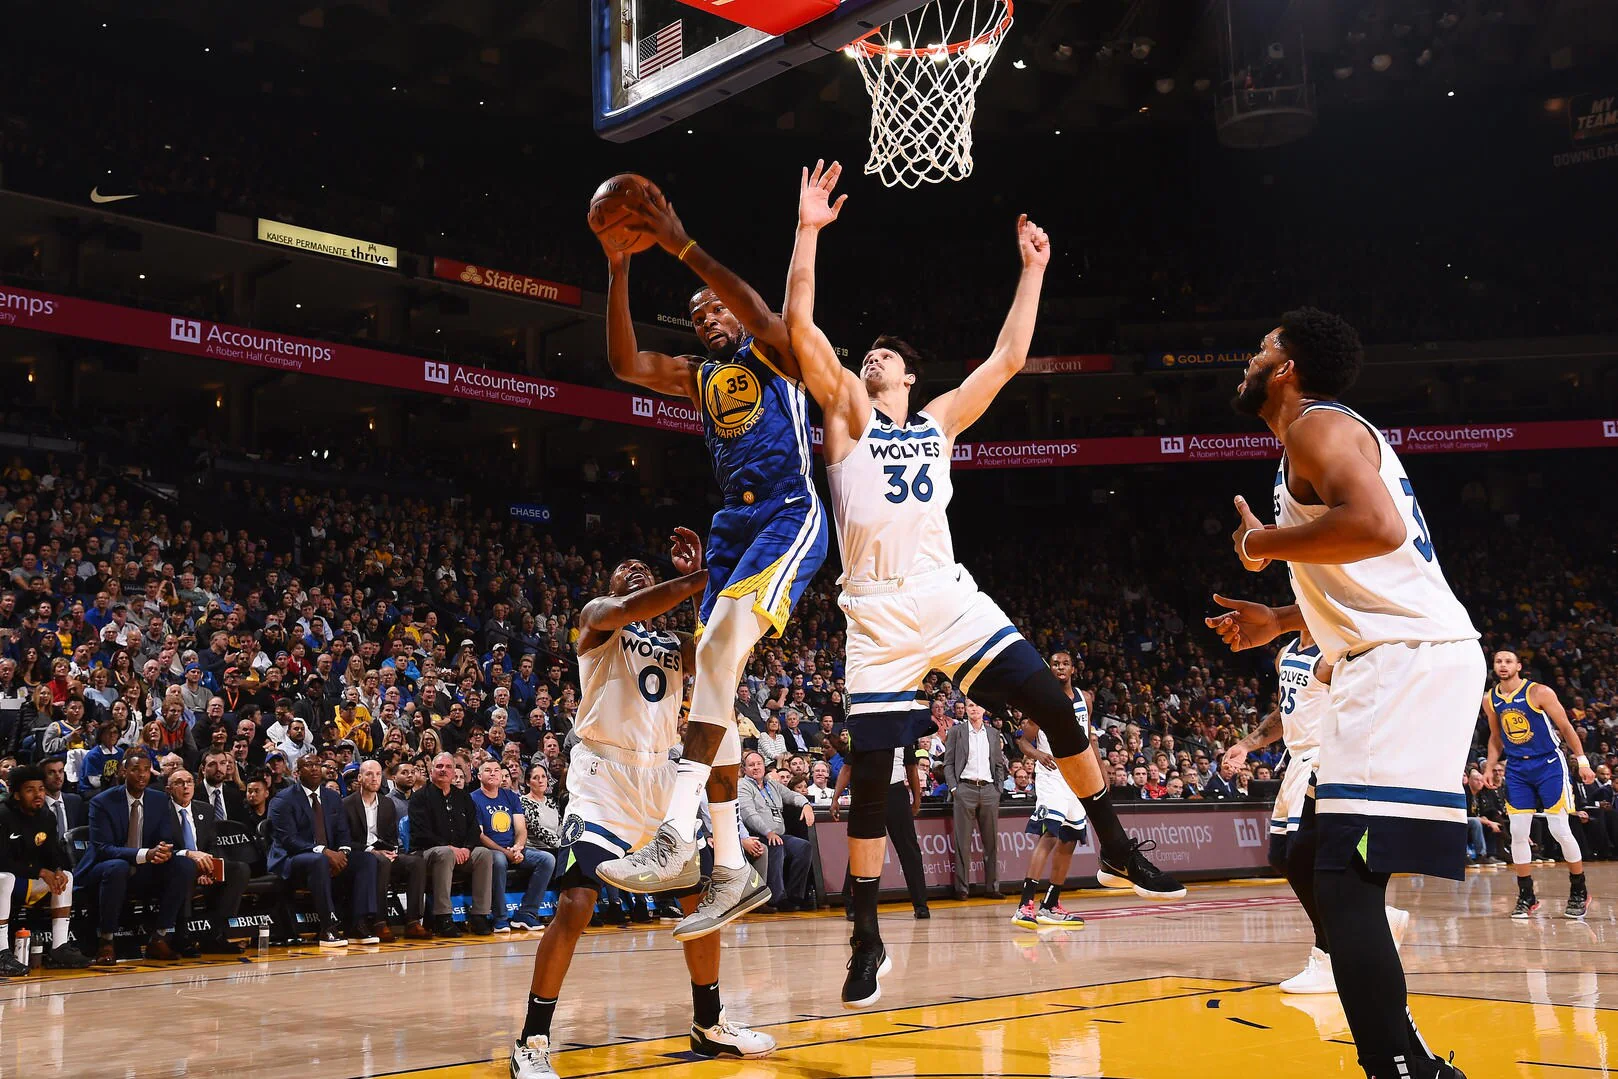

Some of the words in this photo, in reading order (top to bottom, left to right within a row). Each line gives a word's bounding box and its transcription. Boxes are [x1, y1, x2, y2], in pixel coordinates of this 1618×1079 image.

[266, 232, 293, 245] KAISER
[296, 238, 347, 256] PERMANENTE
[350, 245, 388, 264] thrive
[207, 325, 331, 363] Accountemps
[206, 345, 213, 353] A
[216, 346, 243, 359] Robert
[246, 351, 263, 361] Half
[264, 354, 302, 369] Company
[1177, 354, 1214, 364] GOLD
[454, 367, 556, 399] Accountemps
[726, 373, 748, 394] 35
[461, 385, 484, 397] Robert
[486, 390, 500, 400] Half
[501, 392, 532, 405] Company
[663, 418, 682, 429] Robert
[683, 422, 695, 430] Half
[714, 406, 765, 439] WARRIORS
[1407, 428, 1514, 442] Accountemps
[869, 441, 940, 460] WOLVES
[977, 443, 1077, 457] Accountemps
[1455, 441, 1488, 449] Company
[1197, 450, 1218, 458] Robert
[1235, 449, 1267, 457] Company
[1022, 457, 1053, 465] Company
[883, 464, 933, 504] 36
[510, 507, 541, 518] CHASE
[638, 665, 667, 703] 0
[1512, 716, 1523, 725] 30
[488, 805, 509, 814] CITY
[1155, 850, 1190, 863] Company
[237, 914, 274, 928] BRITA
